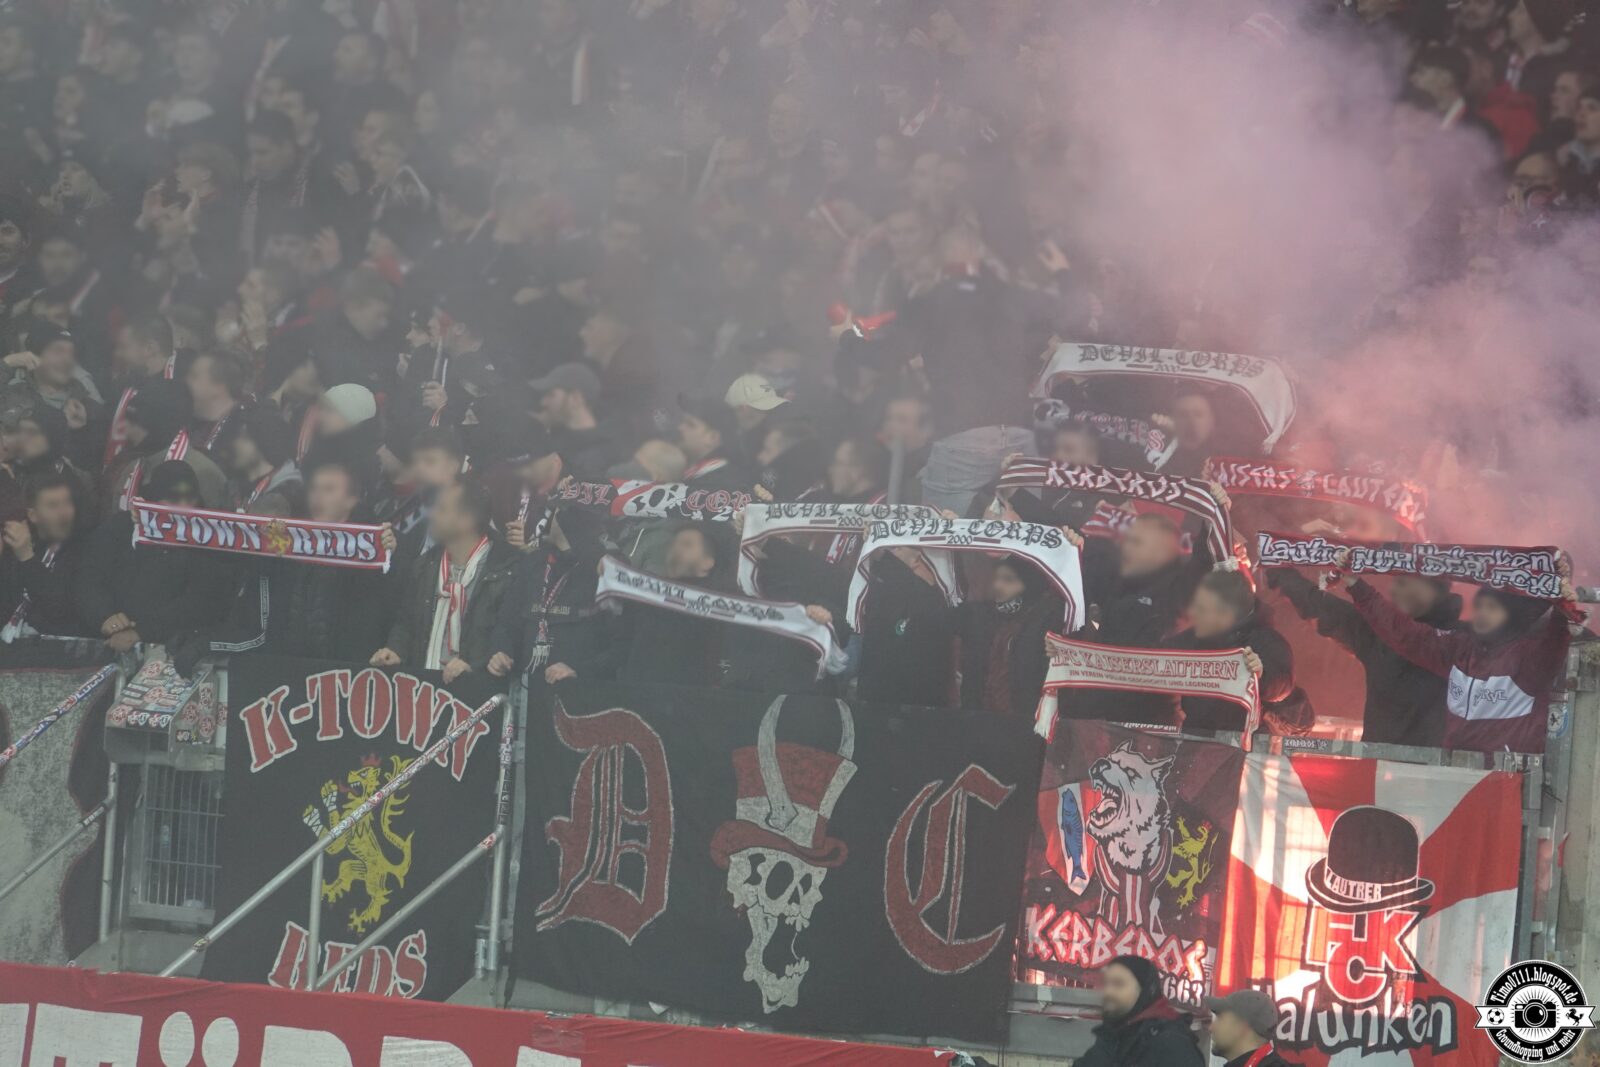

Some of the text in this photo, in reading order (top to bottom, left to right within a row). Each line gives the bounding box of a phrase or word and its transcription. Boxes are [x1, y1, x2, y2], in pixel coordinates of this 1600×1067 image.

[139, 508, 376, 561] K-TOWN REDS
[838, 516, 864, 527] 2000
[947, 534, 973, 545] 2000
[239, 668, 490, 782] K-TOWN
[1326, 872, 1382, 902] LAUTRER
[268, 921, 428, 1000] REDS
[1252, 984, 1452, 1048] alunken
